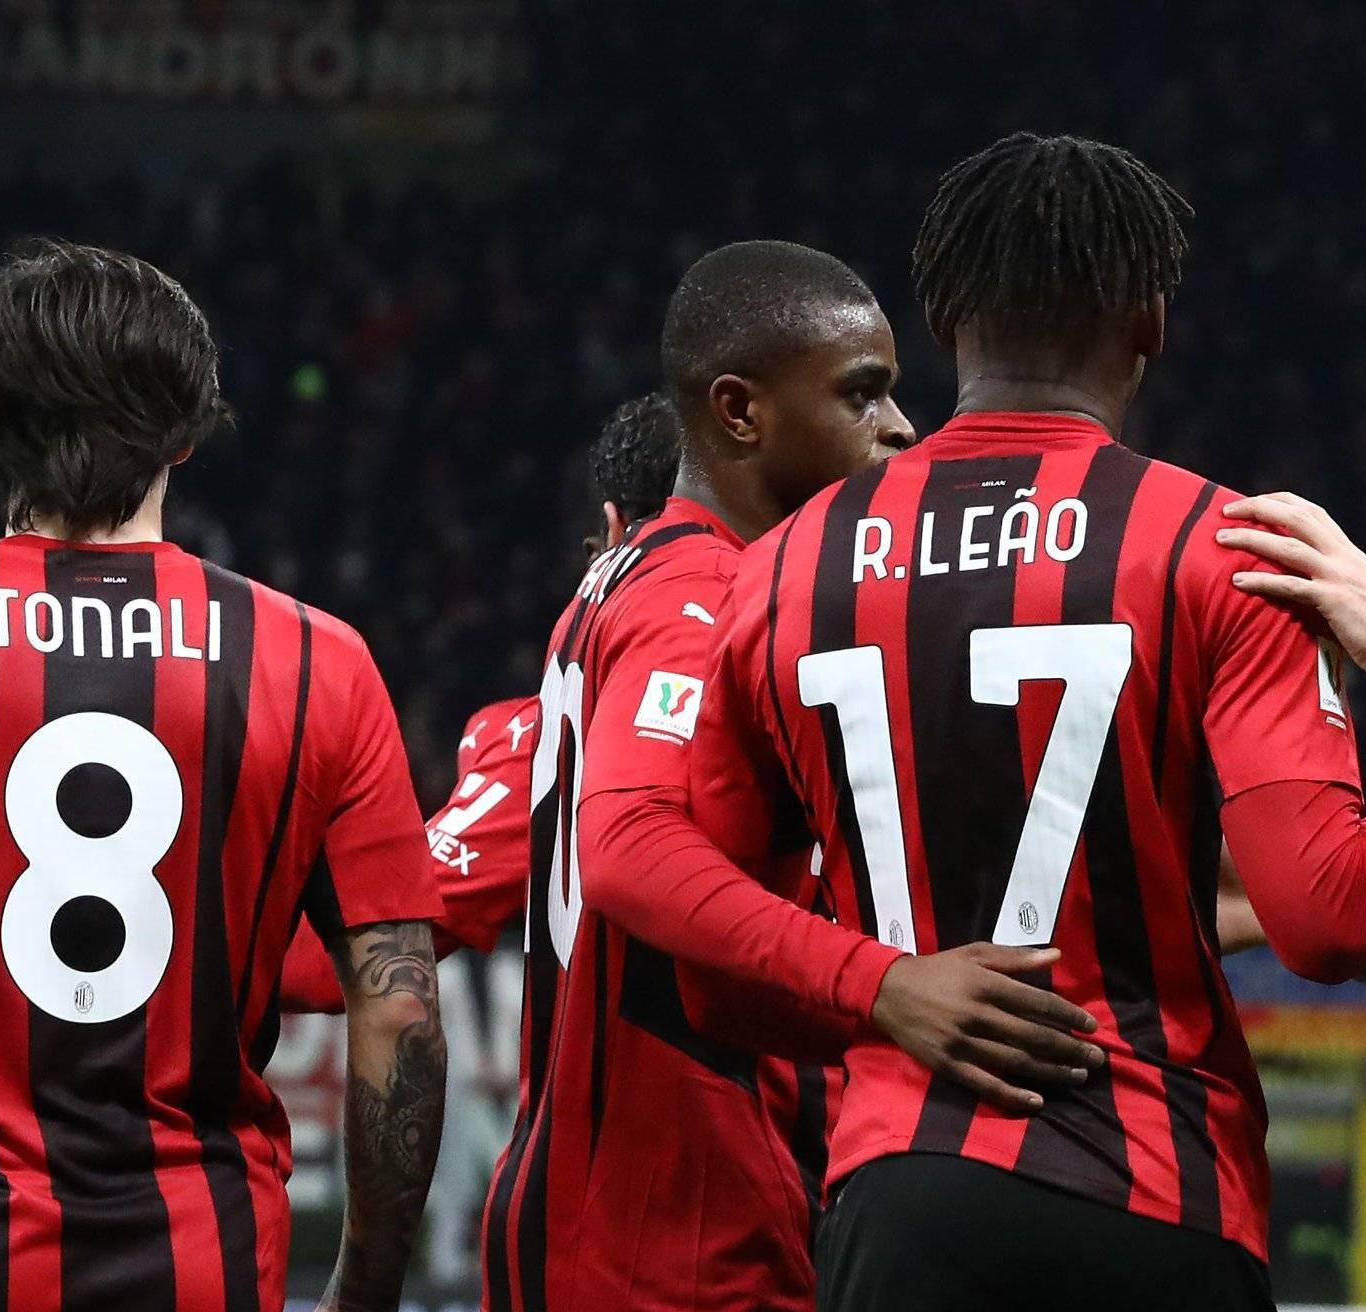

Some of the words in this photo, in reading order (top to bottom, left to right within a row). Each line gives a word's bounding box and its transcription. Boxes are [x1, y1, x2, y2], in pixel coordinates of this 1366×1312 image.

[852, 486, 1089, 584] R.LEÃO
[0, 711, 183, 1024] 8
[797, 623, 1133, 955] 17
